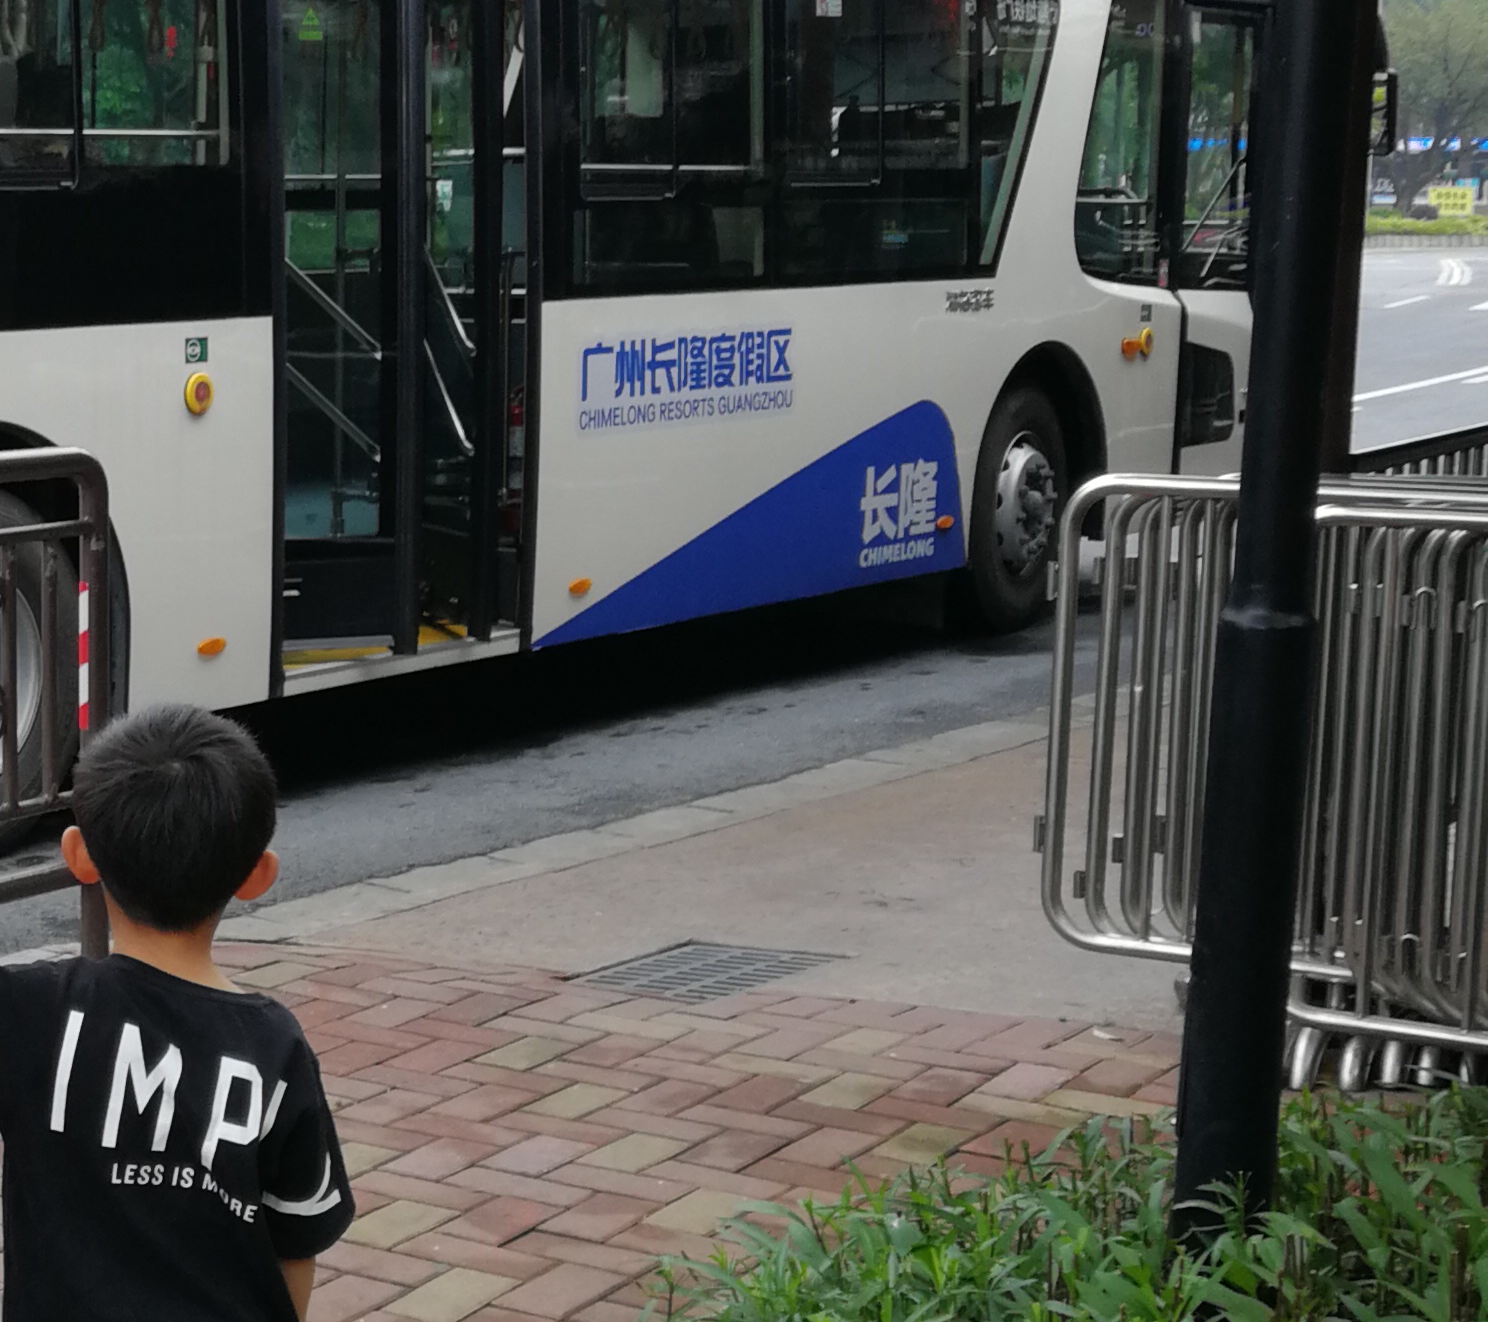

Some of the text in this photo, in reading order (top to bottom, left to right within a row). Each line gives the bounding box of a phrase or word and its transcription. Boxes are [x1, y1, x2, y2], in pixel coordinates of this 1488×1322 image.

[581, 328, 794, 402] 广州长隆度假区
[579, 389, 794, 431] CHIMELONG RESORTS GUANGZHOU
[859, 458, 939, 545] 长隆
[858, 537, 935, 568] CHIMELONG
[111, 1163, 259, 1223] LESS IS MORE
